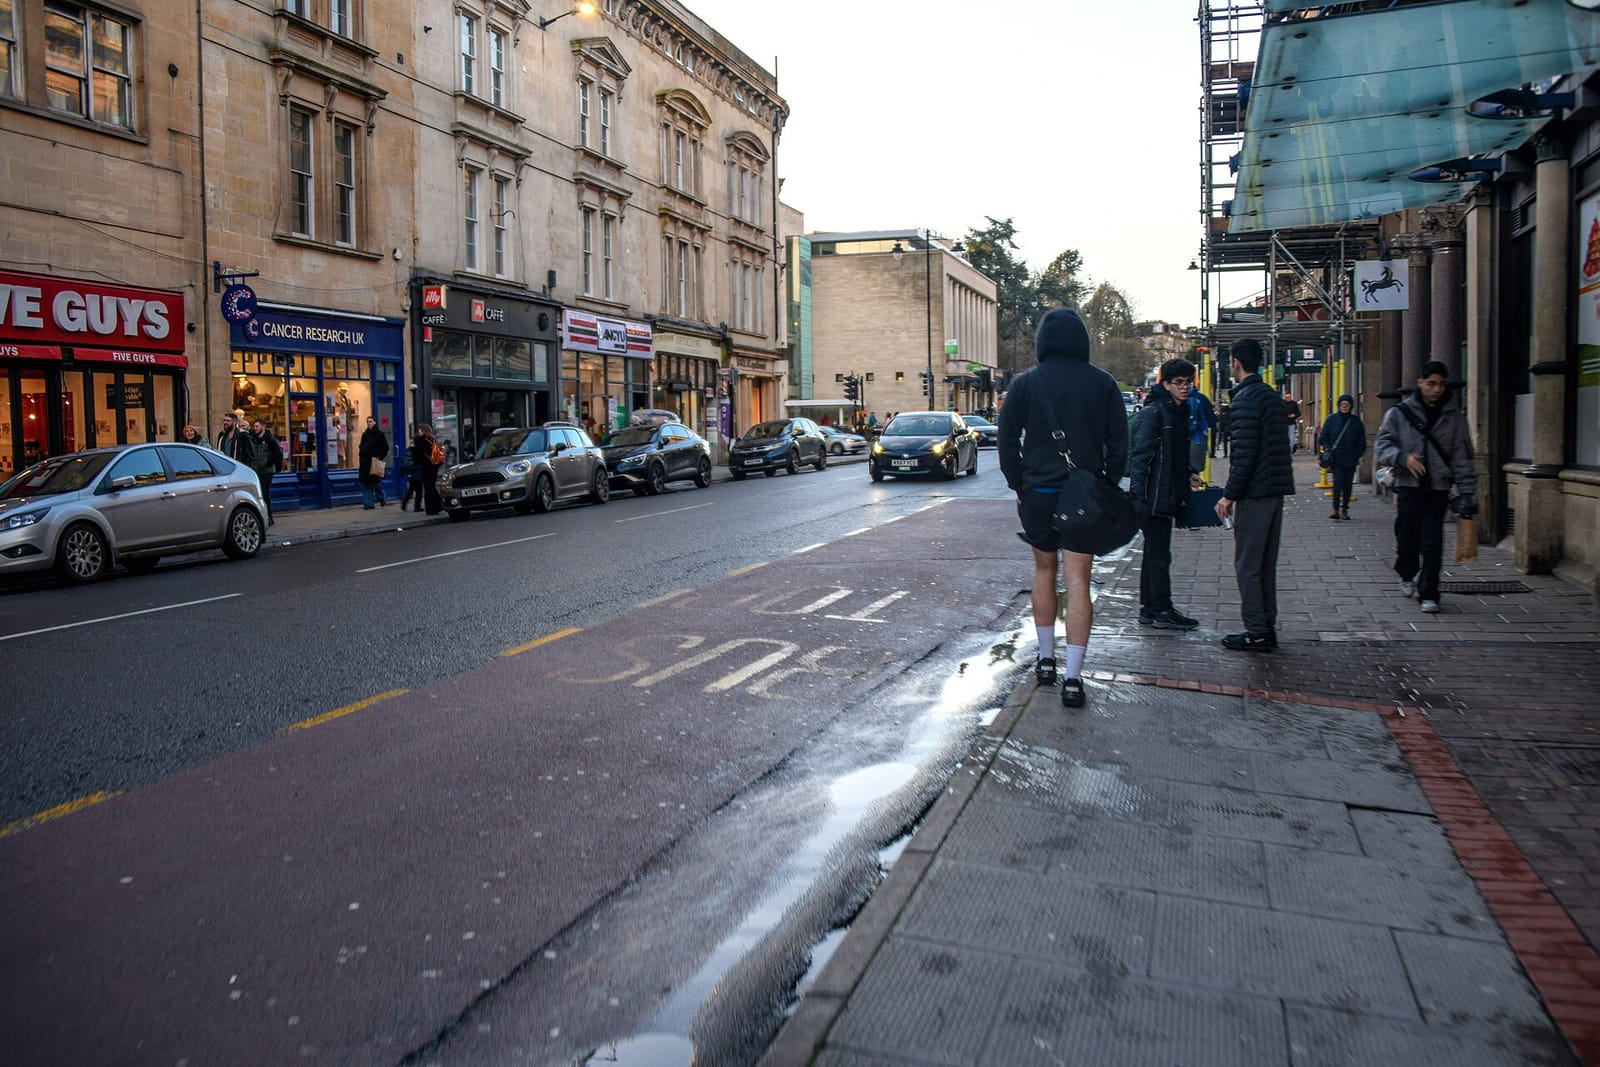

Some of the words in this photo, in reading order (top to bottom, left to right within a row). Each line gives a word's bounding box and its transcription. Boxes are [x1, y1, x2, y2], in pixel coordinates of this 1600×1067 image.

[426, 290, 441, 305] illy
[52, 290, 170, 339] GUYS
[262, 322, 303, 339] CANCER
[306, 326, 351, 343] RESEARCH
[352, 332, 364, 345] UK
[113, 352, 132, 362] FIVE
[132, 353, 156, 364] GUYS
